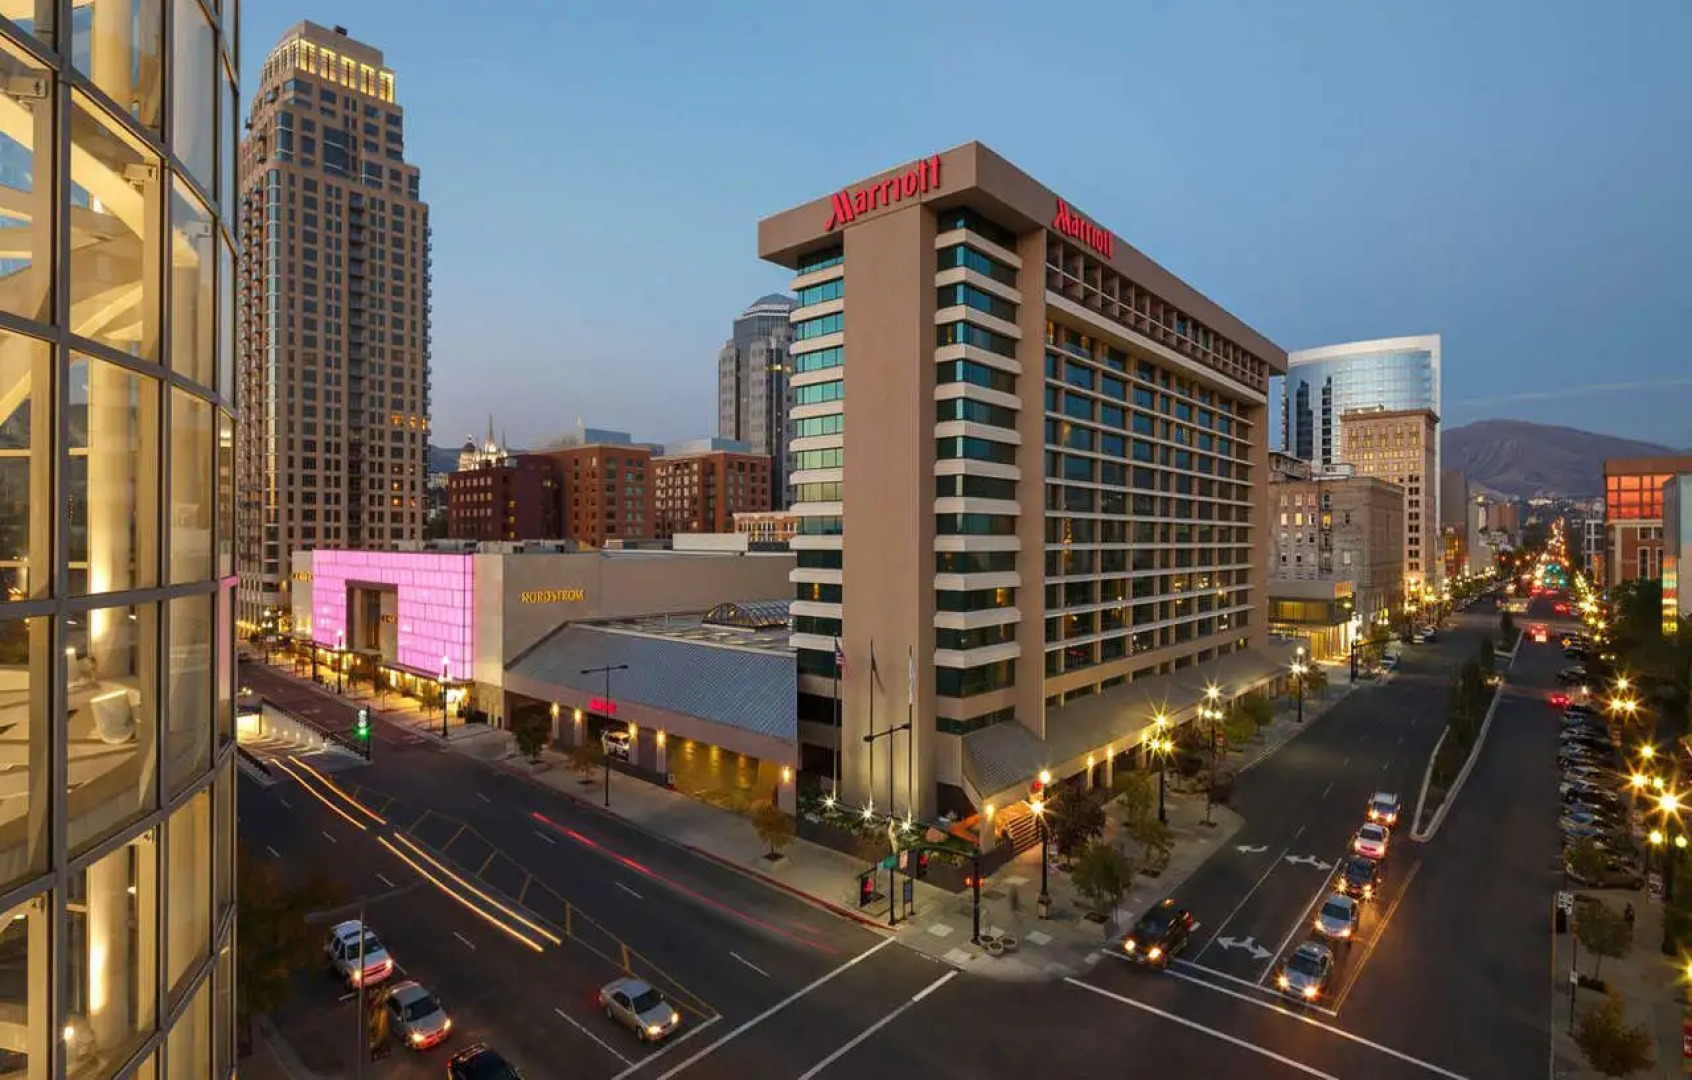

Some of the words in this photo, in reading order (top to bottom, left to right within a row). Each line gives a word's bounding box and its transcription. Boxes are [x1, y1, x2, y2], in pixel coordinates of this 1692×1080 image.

[825, 154, 940, 231] Marriott
[1053, 196, 1114, 259] Marriott
[521, 588, 584, 604] NORDSTROM
